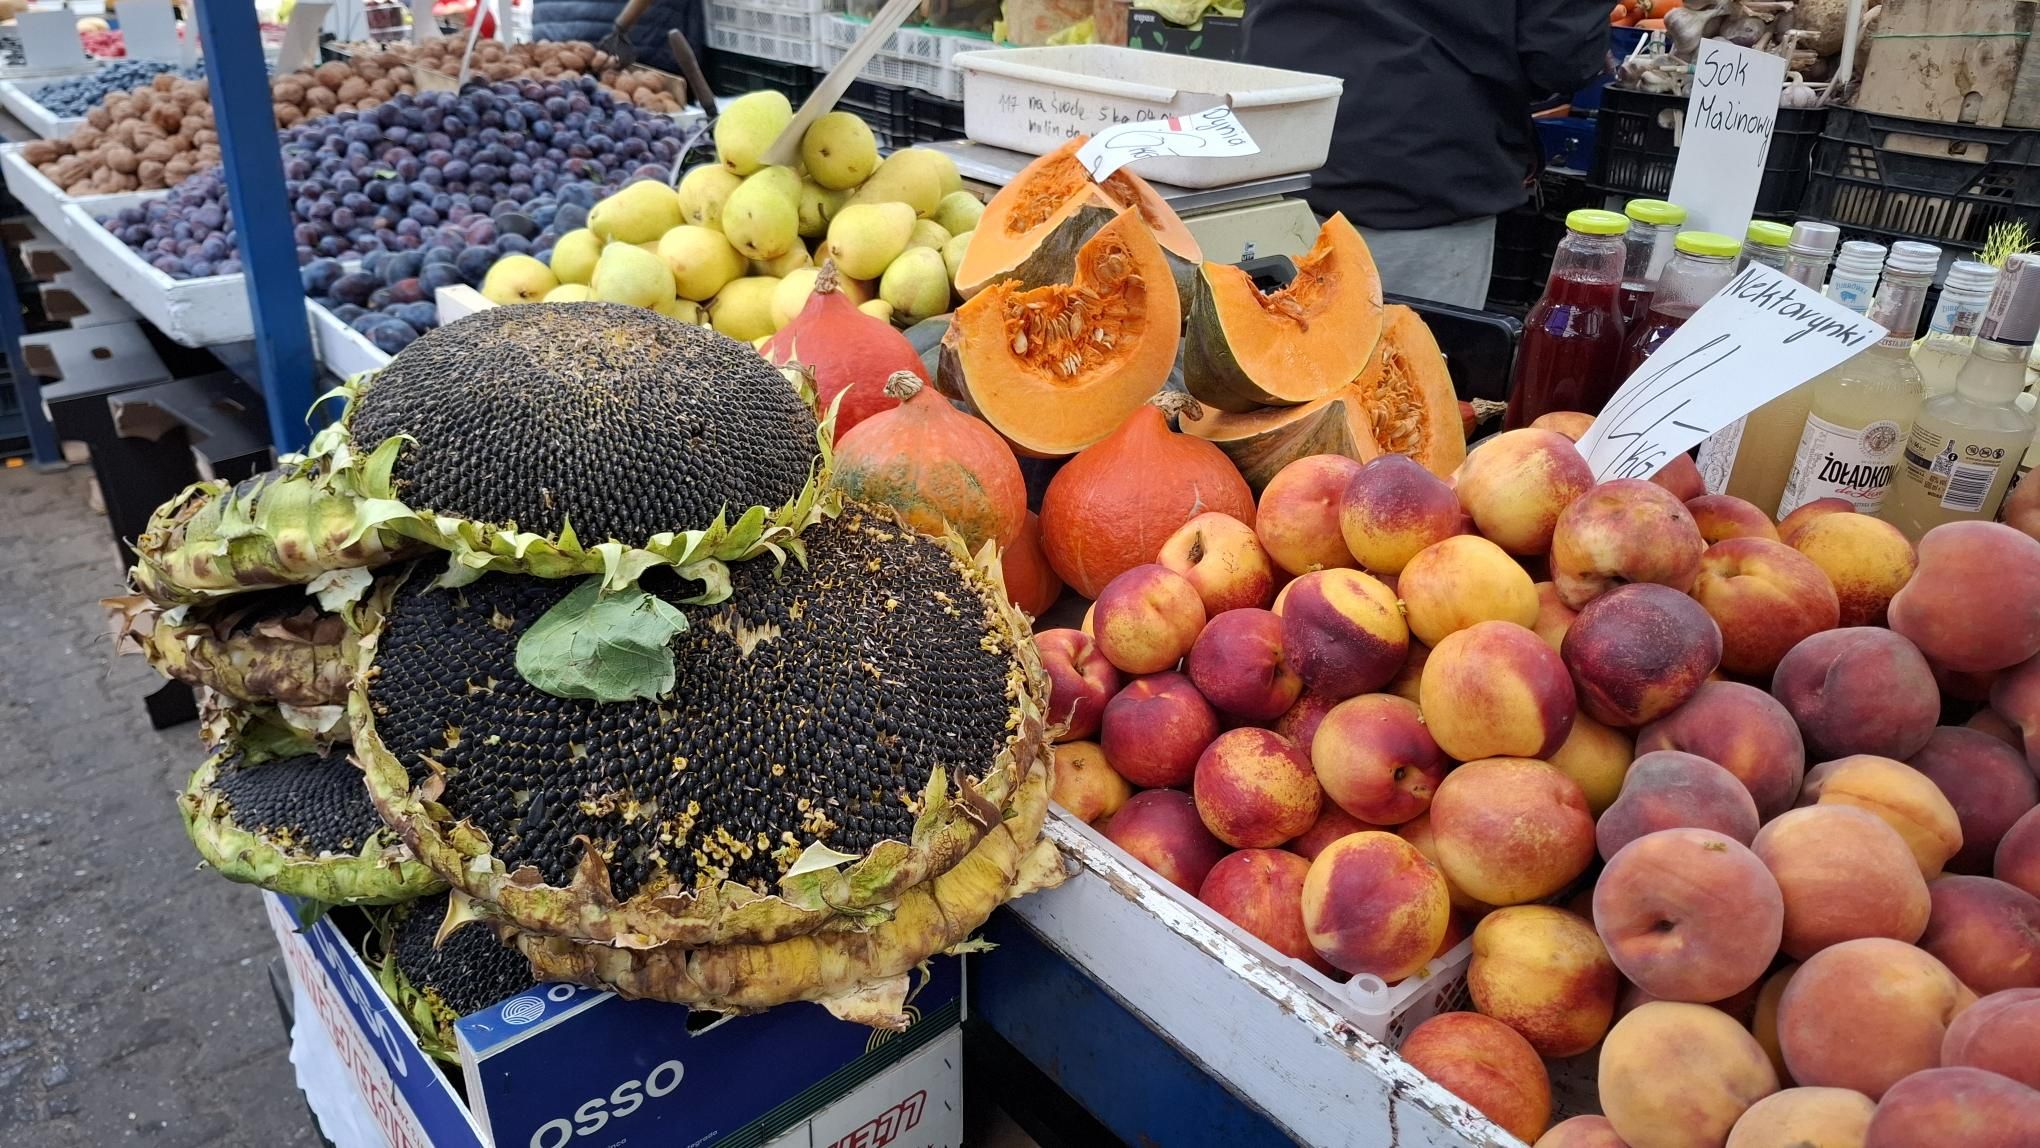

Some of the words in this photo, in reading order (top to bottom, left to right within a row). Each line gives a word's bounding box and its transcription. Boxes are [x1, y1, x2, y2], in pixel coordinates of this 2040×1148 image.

[1698, 49, 1749, 87] Sok
[1195, 108, 1247, 147] Dynia
[1694, 95, 1774, 168] Malinowy
[1721, 268, 1873, 346] Nektarynki
[530, 1060, 685, 1148] OSSO
